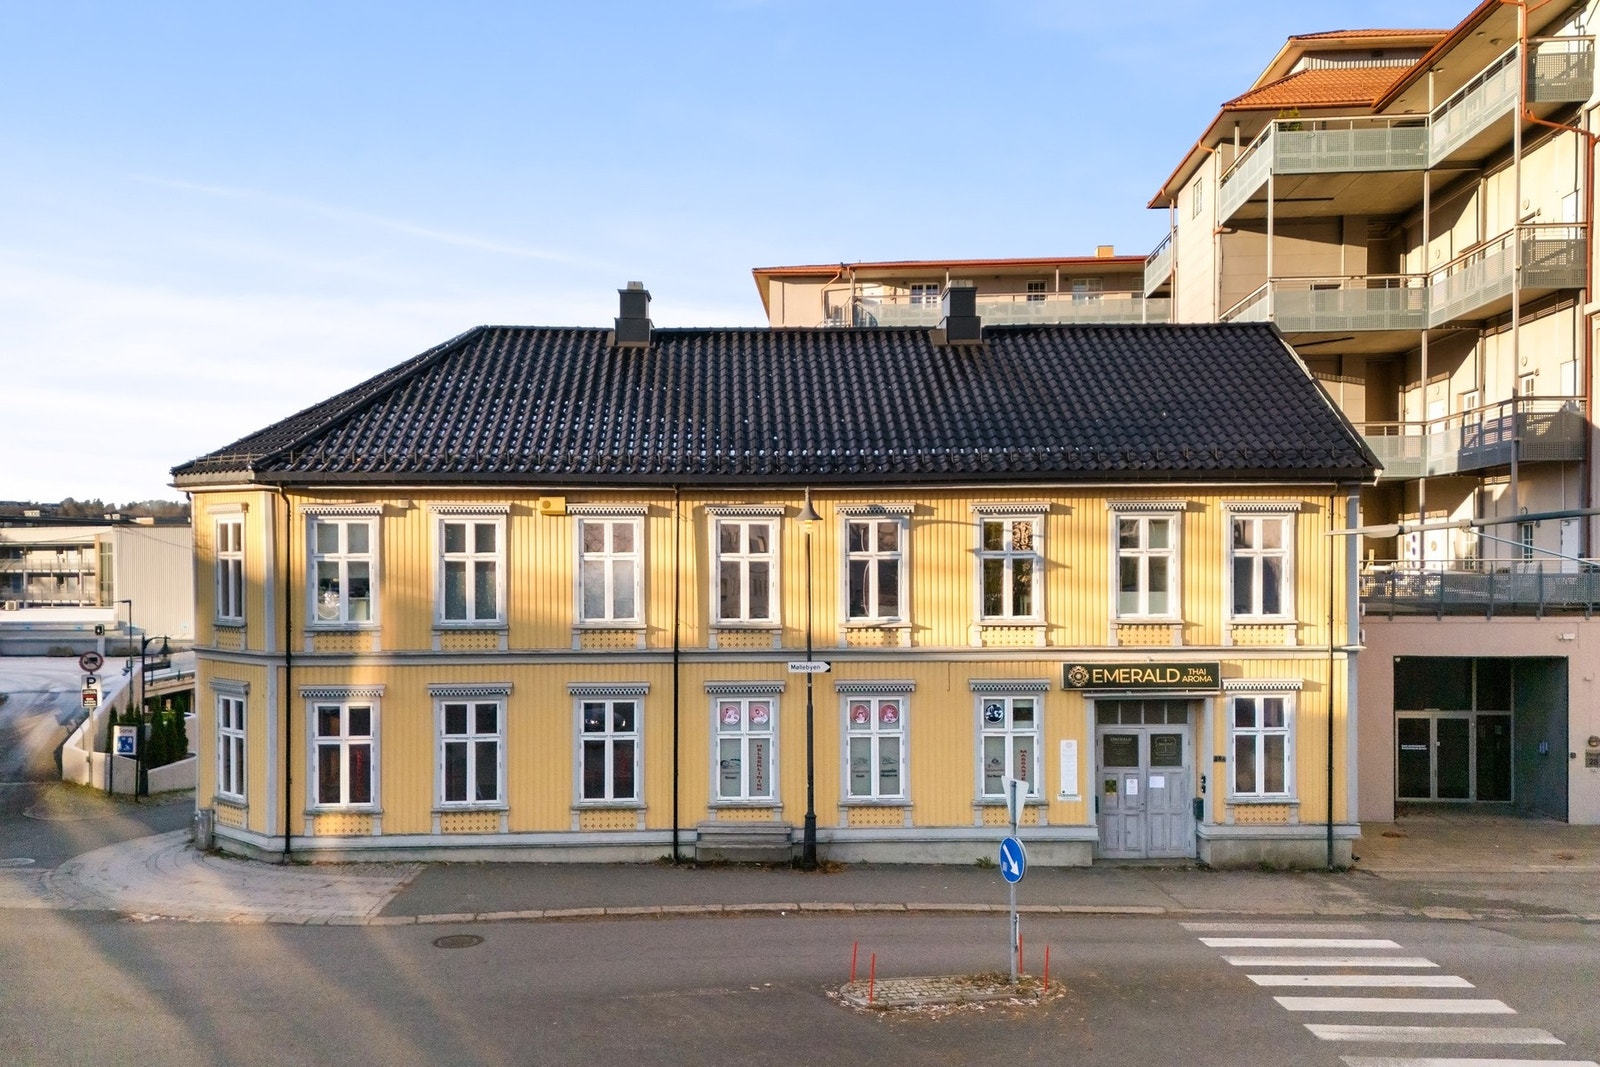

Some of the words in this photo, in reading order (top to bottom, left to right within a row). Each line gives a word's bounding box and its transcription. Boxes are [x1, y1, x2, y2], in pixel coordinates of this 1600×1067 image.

[1092, 668, 1180, 683] EMERALD
[1181, 675, 1213, 683] AROMA
[87, 677, 96, 688] P
